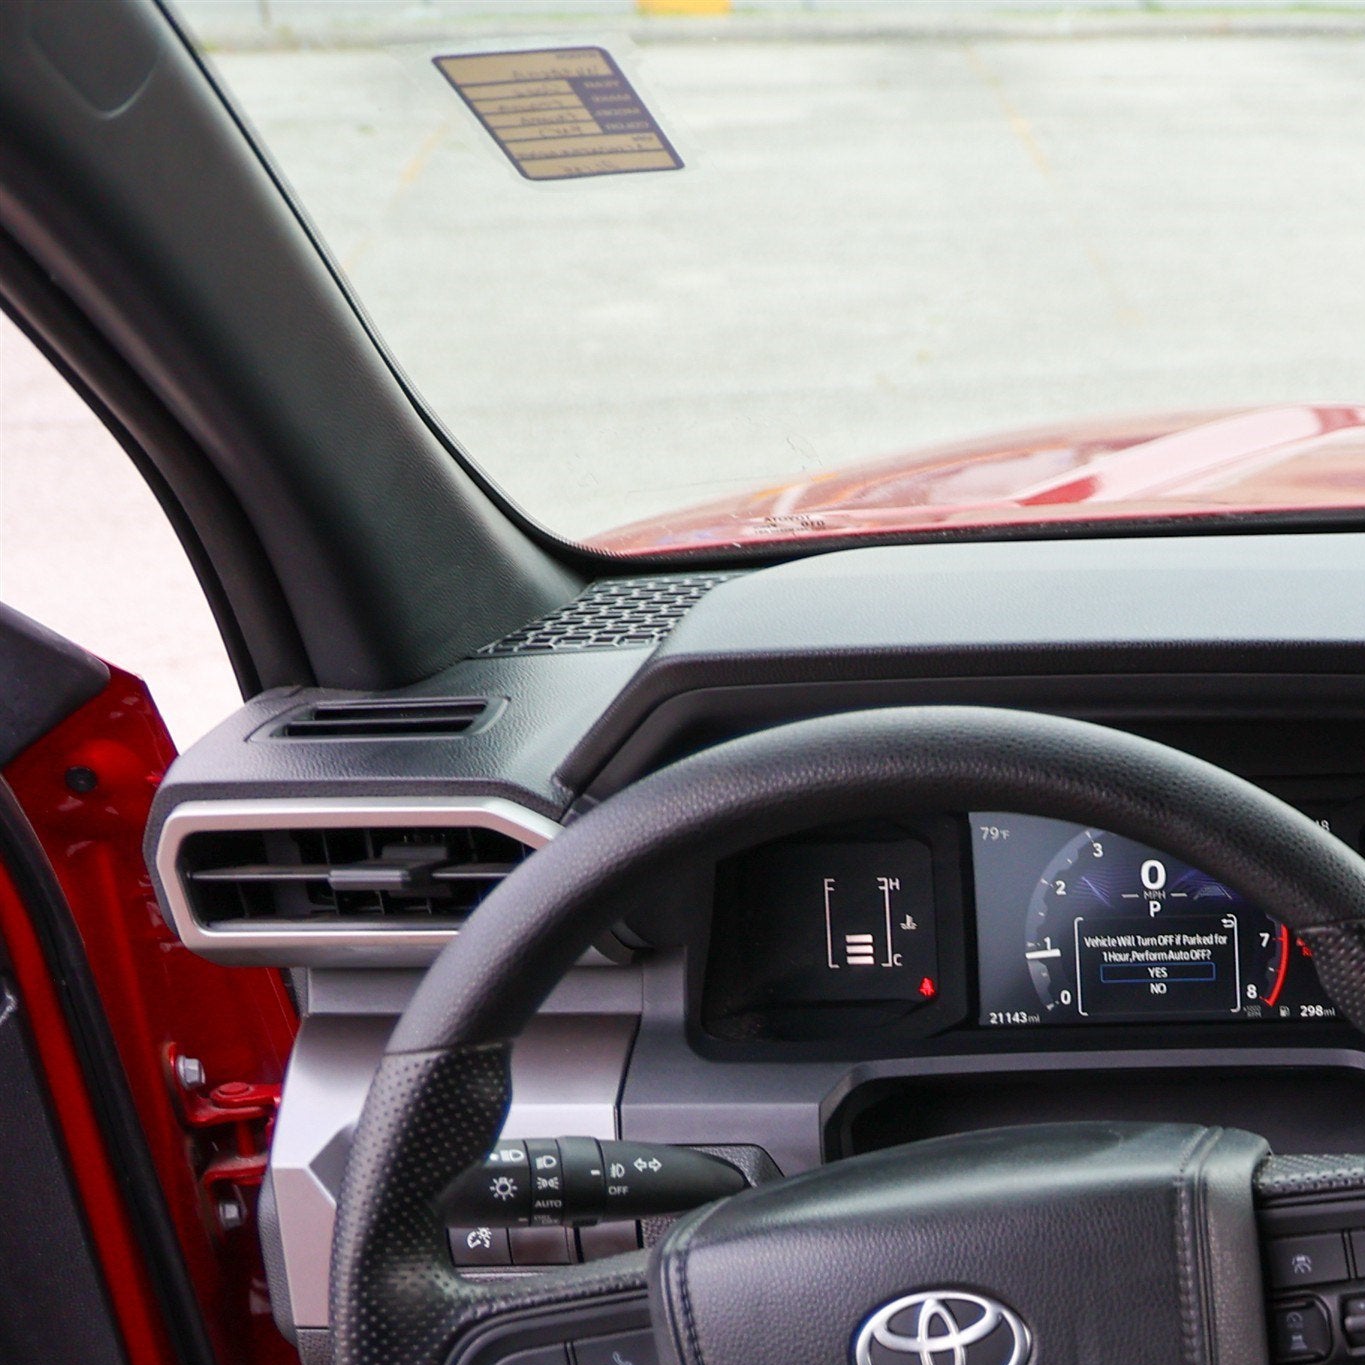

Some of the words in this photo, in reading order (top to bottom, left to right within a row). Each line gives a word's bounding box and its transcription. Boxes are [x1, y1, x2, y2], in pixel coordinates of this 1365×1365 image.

[1092, 843, 1104, 858] 3
[1140, 859, 1166, 890] 0
[889, 877, 901, 890] H
[1055, 880, 1067, 896] 2
[1149, 901, 1162, 918] P
[1084, 936, 1117, 948] Vehicle
[1117, 935, 1136, 947] Will
[1137, 935, 1157, 947] Turn
[1157, 934, 1174, 946] OFF
[1174, 933, 1182, 946] if
[1182, 933, 1214, 946] Parked
[1214, 932, 1228, 945] for
[1259, 933, 1271, 948] 7
[893, 953, 903, 966] C
[1168, 950, 1190, 961] Auto
[1190, 949, 1212, 961] OFF?
[1148, 966, 1169, 979] YES
[1149, 983, 1167, 995] NO
[1246, 984, 1258, 1000] 8
[1059, 989, 1071, 1005] 0
[608, 1185, 629, 1196] OFF
[534, 1199, 562, 1209] AUTO
